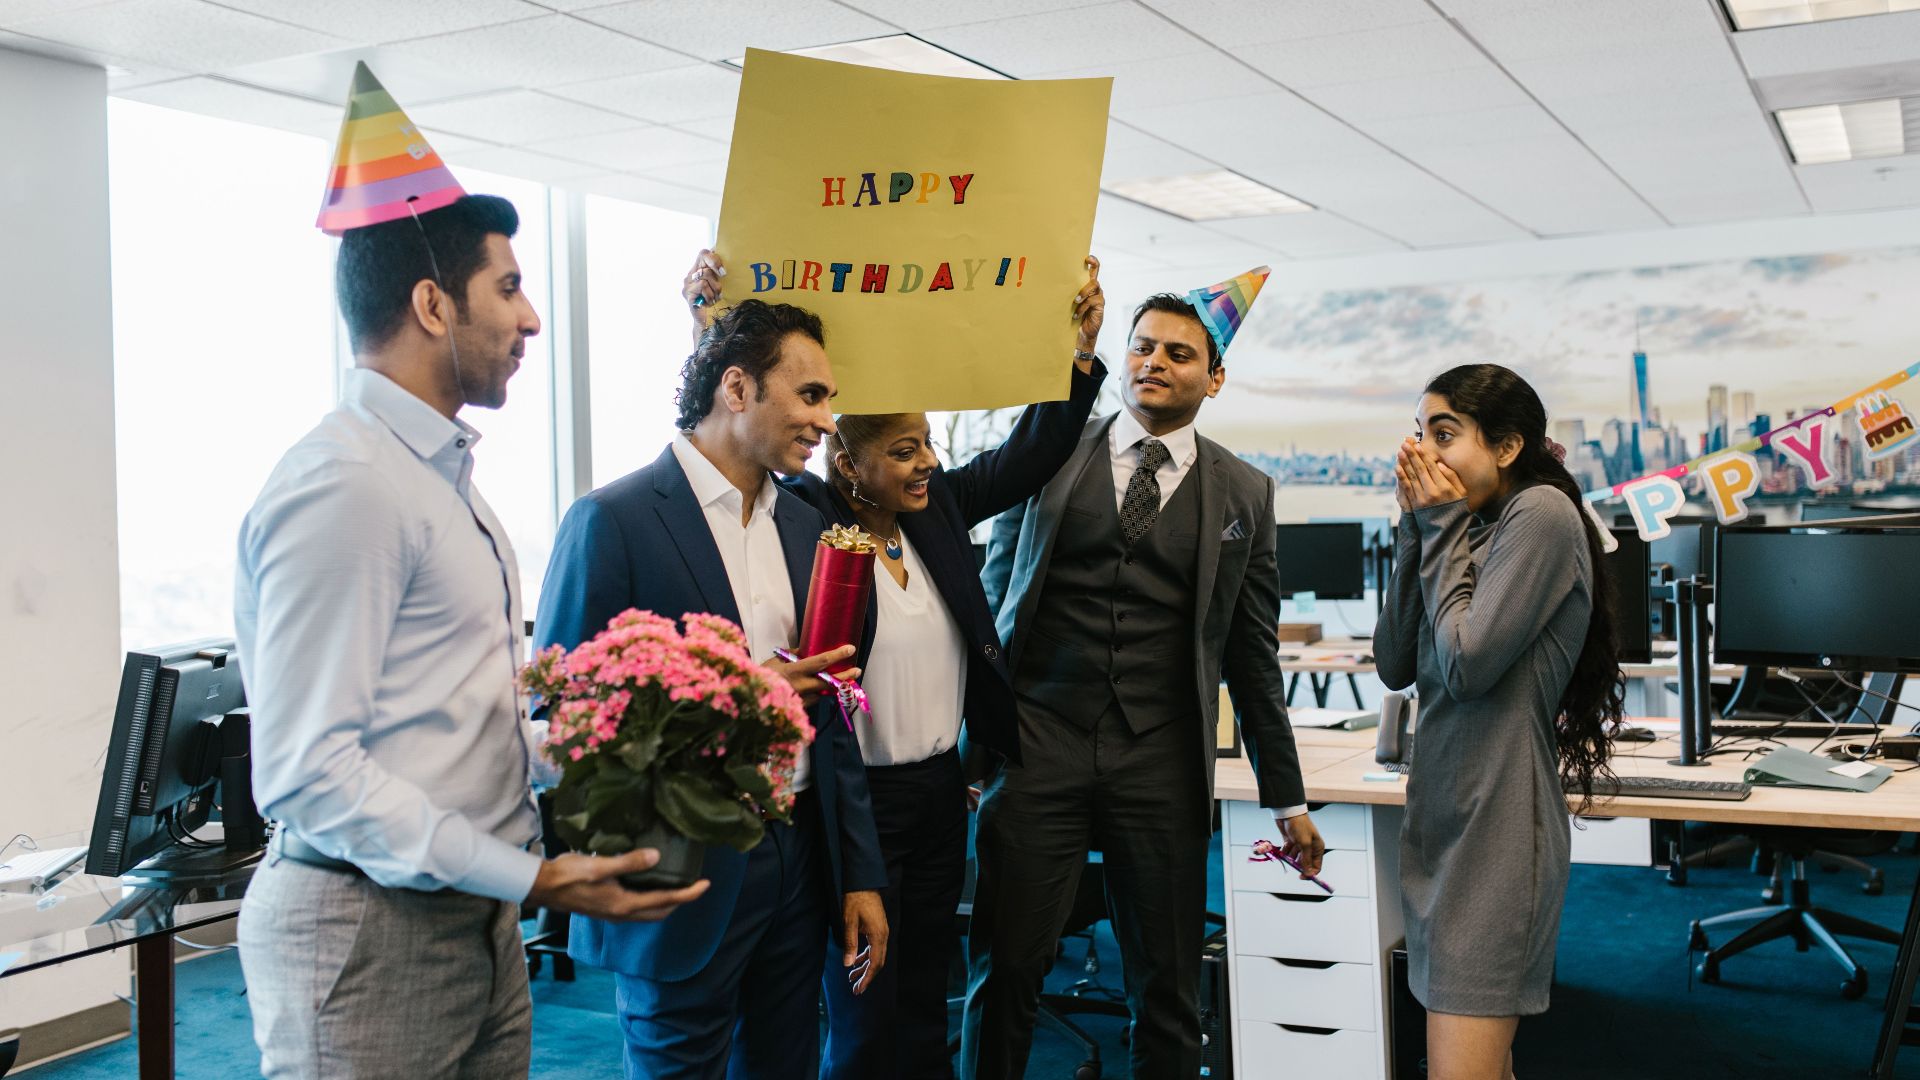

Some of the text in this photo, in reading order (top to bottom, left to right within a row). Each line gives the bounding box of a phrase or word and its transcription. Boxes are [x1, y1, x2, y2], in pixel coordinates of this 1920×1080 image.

[821, 171, 975, 208] HAPPY
[749, 256, 1027, 294] BIRTHDAY!!
[1587, 417, 1837, 552] PPY
